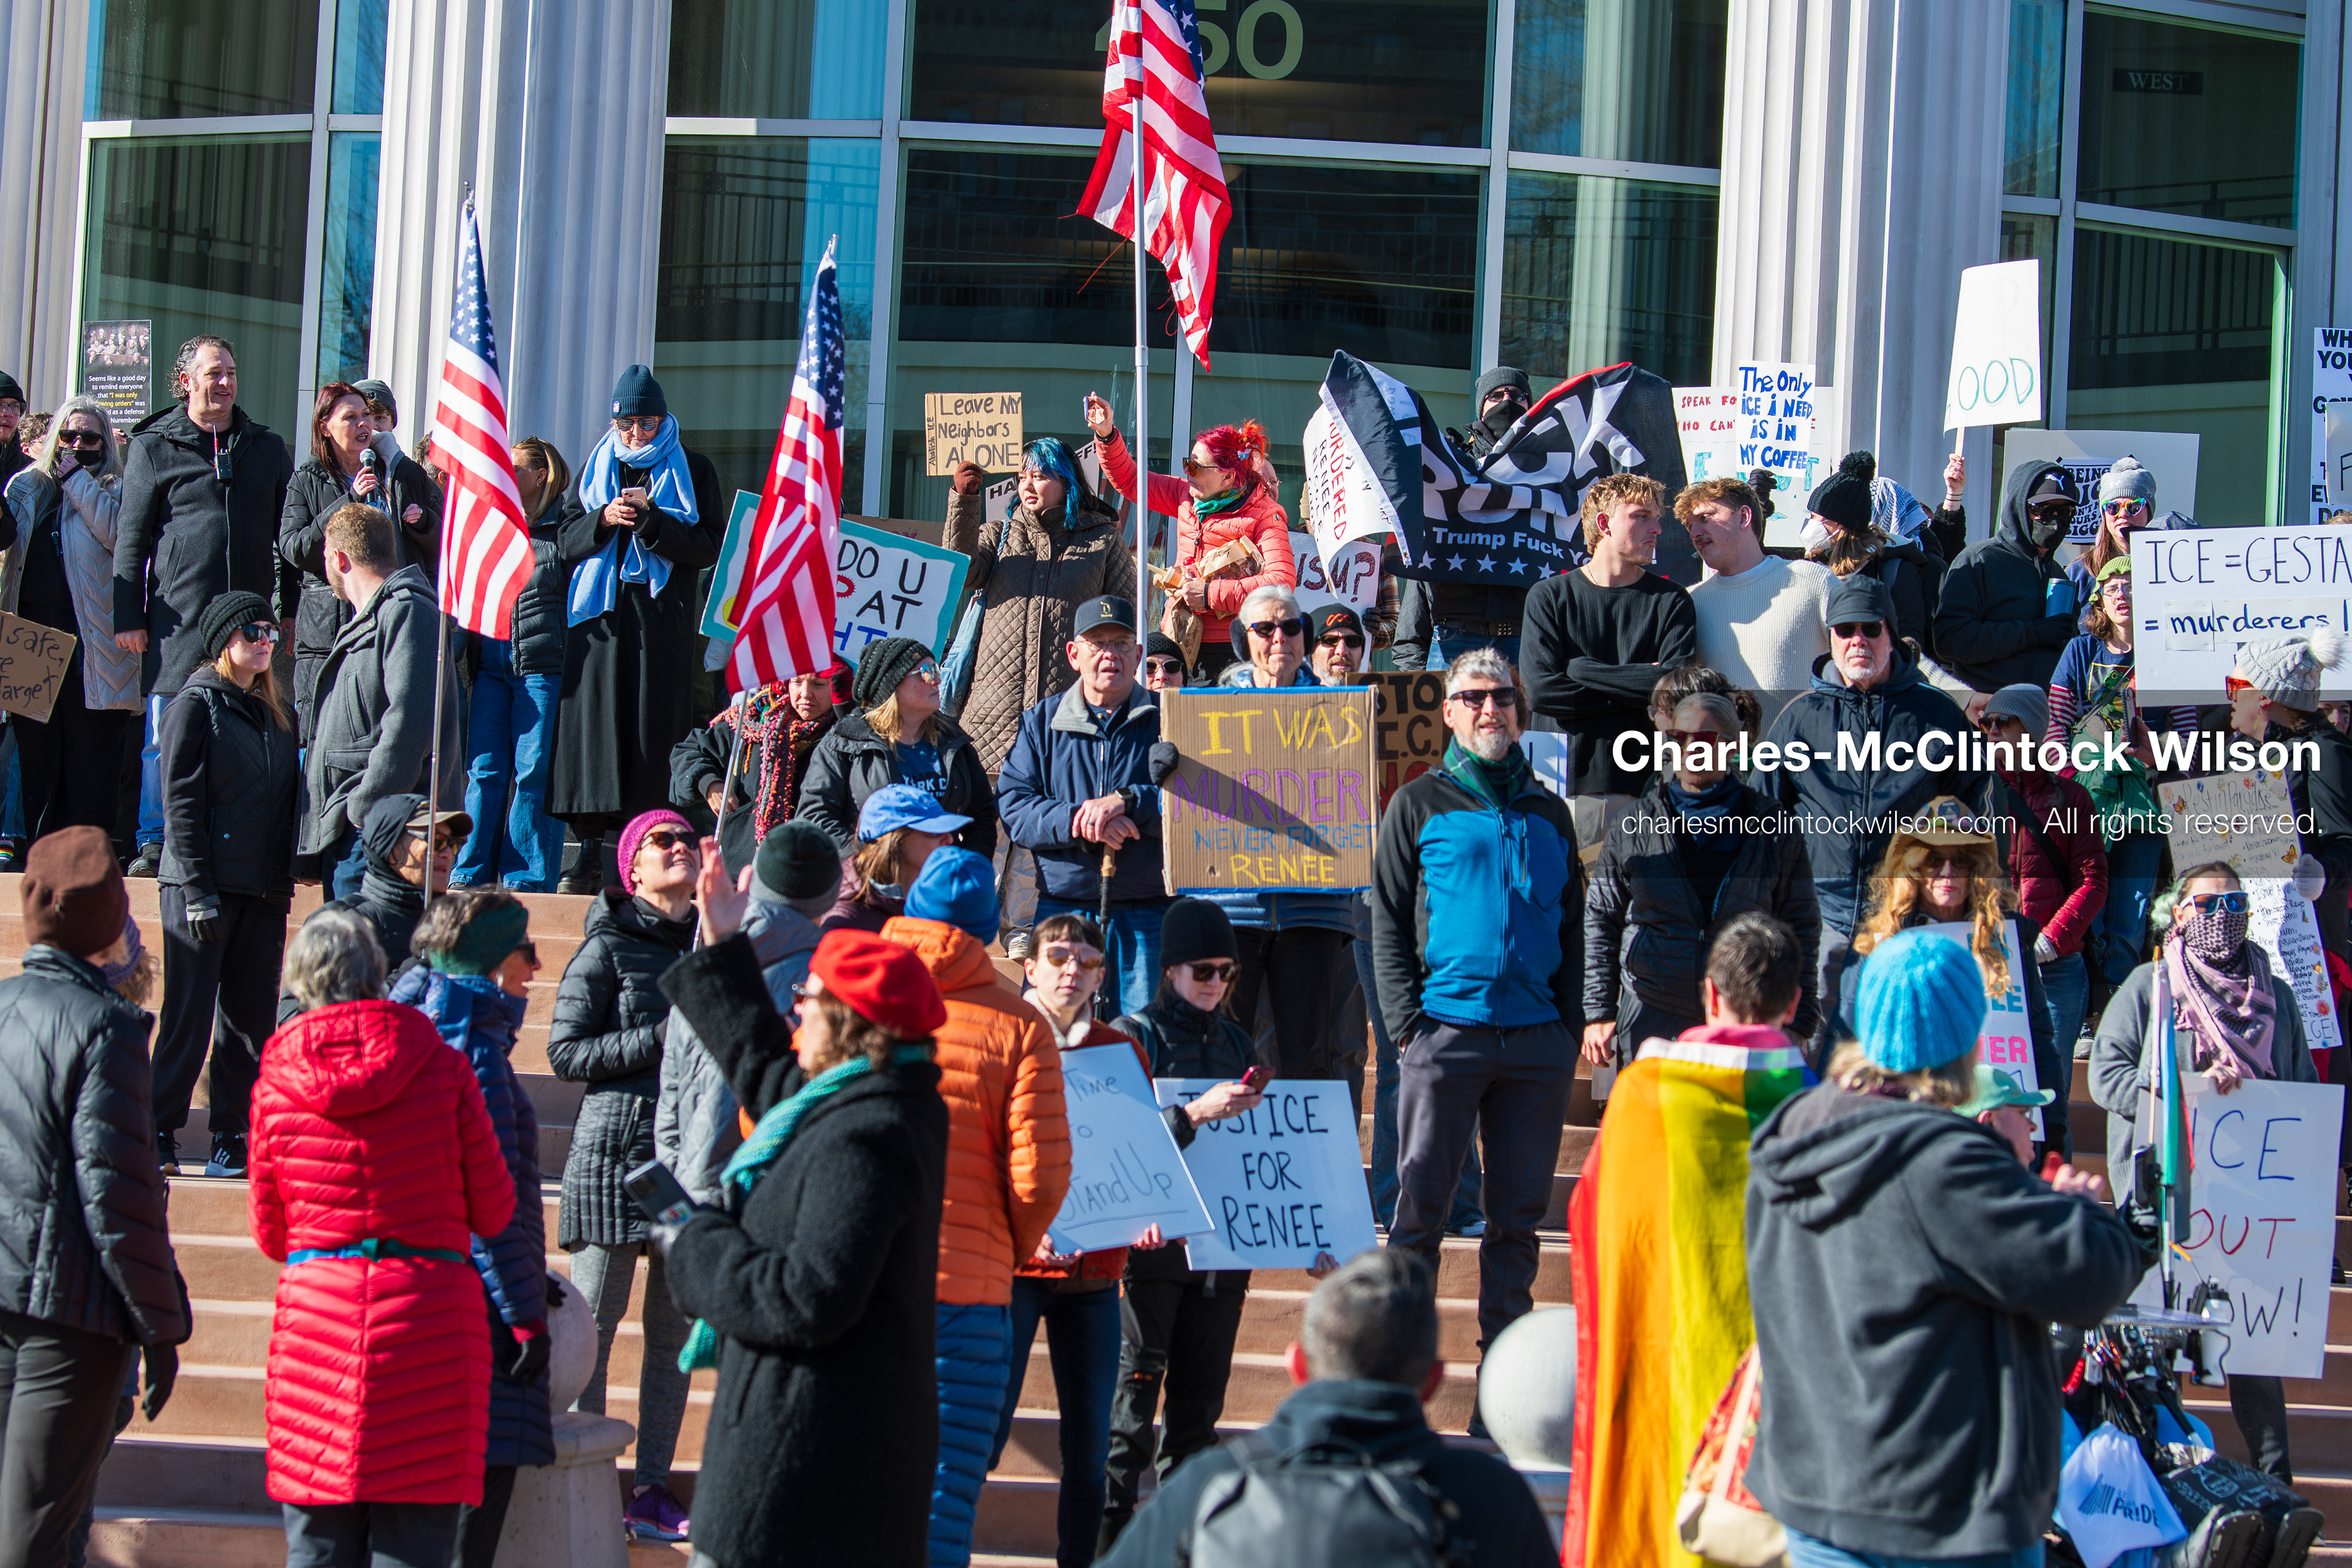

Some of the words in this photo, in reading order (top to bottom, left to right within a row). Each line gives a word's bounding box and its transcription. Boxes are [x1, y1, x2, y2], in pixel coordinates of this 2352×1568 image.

[2128, 72, 2188, 91] WEST
[1739, 367, 1773, 393] The
[1777, 370, 1813, 399] Only
[1945, 358, 2034, 418] OOD
[940, 394, 993, 416] Leave
[1000, 394, 1022, 414] MY
[1682, 396, 1711, 409] SPEAK
[1722, 395, 1737, 405] FO
[1783, 398, 1813, 420] NEED
[926, 417, 935, 431] ICE
[938, 421, 1010, 447] Neighbors
[1677, 421, 1700, 432] HO
[1710, 419, 1736, 431] CAN'
[1740, 443, 1758, 466] MY
[1761, 446, 1808, 469] COFFEE
[990, 481, 1017, 500] HA
[1319, 439, 1331, 518] RENEE
[1432, 527, 1506, 550] Trump
[1512, 531, 1564, 560] Fuck
[1568, 547, 1593, 566] Yo
[2145, 539, 2215, 584] ICE
[838, 539, 880, 579] DO
[899, 558, 927, 594] U
[1295, 551, 1376, 603] ISM?
[856, 590, 923, 630] AT
[2170, 603, 2330, 635] murderers
[7, 627, 65, 668] safe,
[1378, 674, 1443, 715] TO
[1198, 709, 1263, 755] IT
[1273, 705, 1363, 750] WAS
[1173, 767, 1371, 824] MURDER
[1194, 826, 1276, 851] NEVER
[1287, 823, 1377, 851] FORGET
[1229, 853, 1336, 886] RENEE
[2302, 1018, 2337, 1042] CE!
[1976, 1034, 2029, 1064] ER
[1113, 1142, 1173, 1199] Up
[1242, 1152, 1302, 1191] FOR
[1221, 1196, 1331, 1251] RENEE
